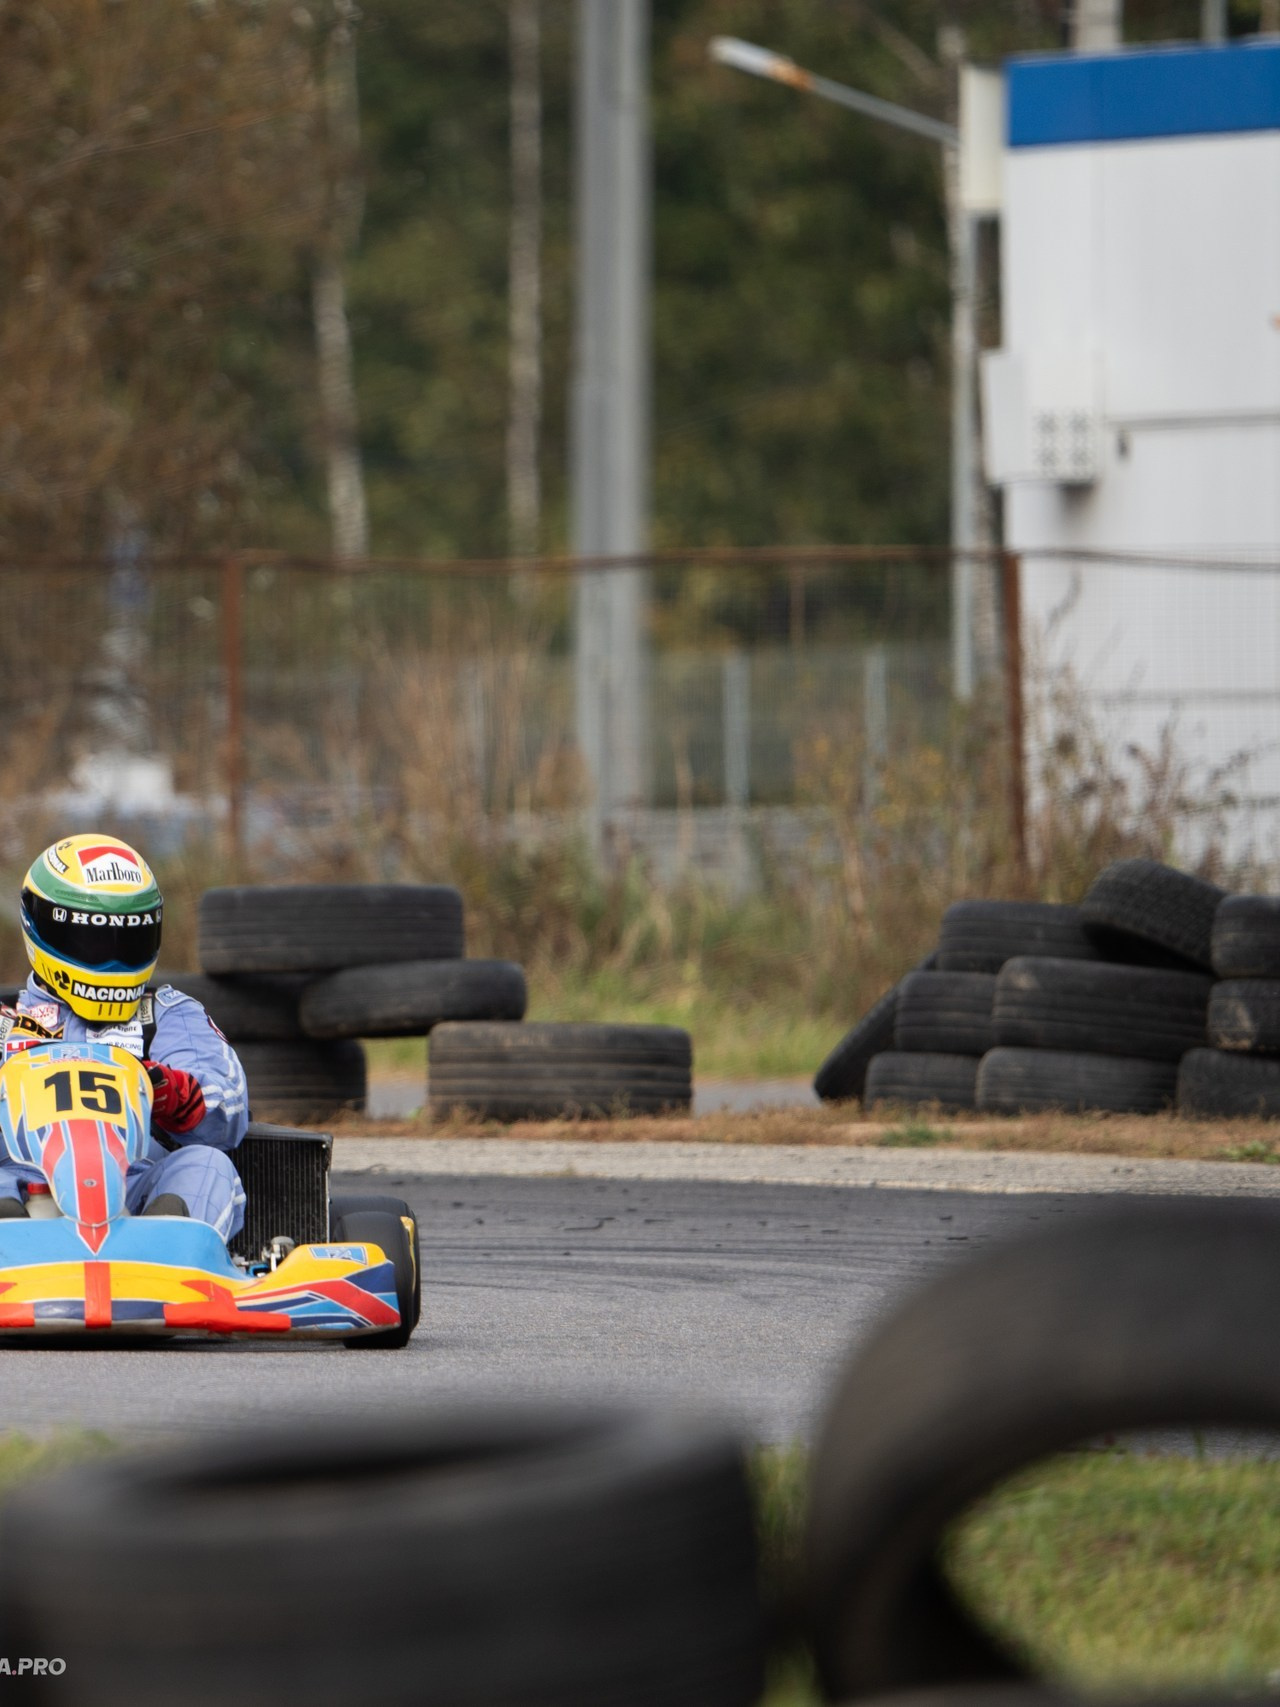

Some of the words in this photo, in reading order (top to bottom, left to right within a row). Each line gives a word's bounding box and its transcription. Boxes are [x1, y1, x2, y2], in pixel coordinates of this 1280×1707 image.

[86, 862, 141, 883] Marlboro
[71, 912, 154, 927] HONDA
[44, 1071, 122, 1114] 15
